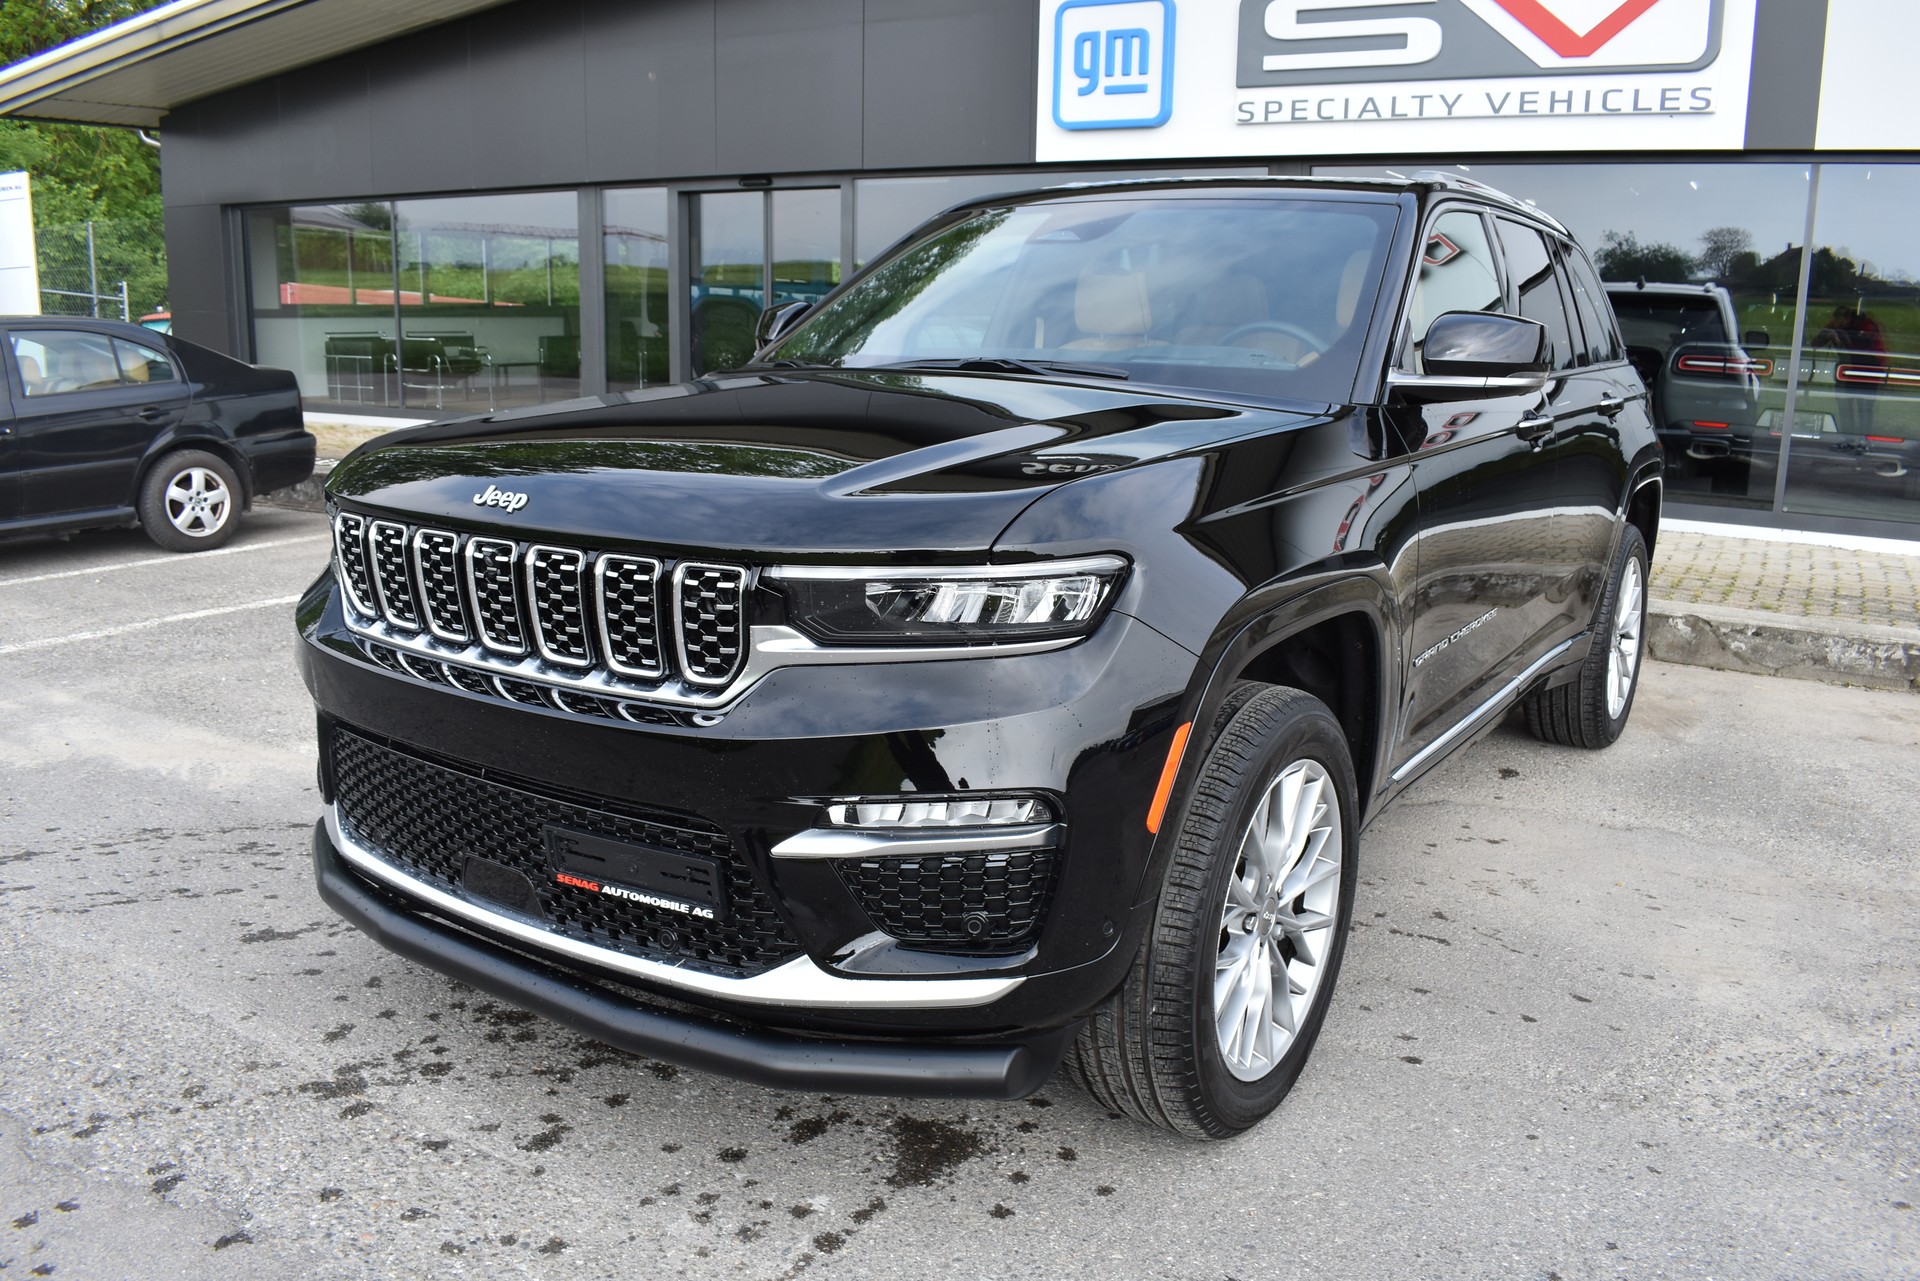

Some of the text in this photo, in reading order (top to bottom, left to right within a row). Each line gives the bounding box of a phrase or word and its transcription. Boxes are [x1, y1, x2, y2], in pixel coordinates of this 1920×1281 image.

[1074, 28, 1150, 96] gm
[1237, 86, 1713, 122] SPECIALTY VEHICLES
[473, 485, 529, 513] Jeep
[556, 873, 714, 919] SENAG AUTOMOBILE AG
